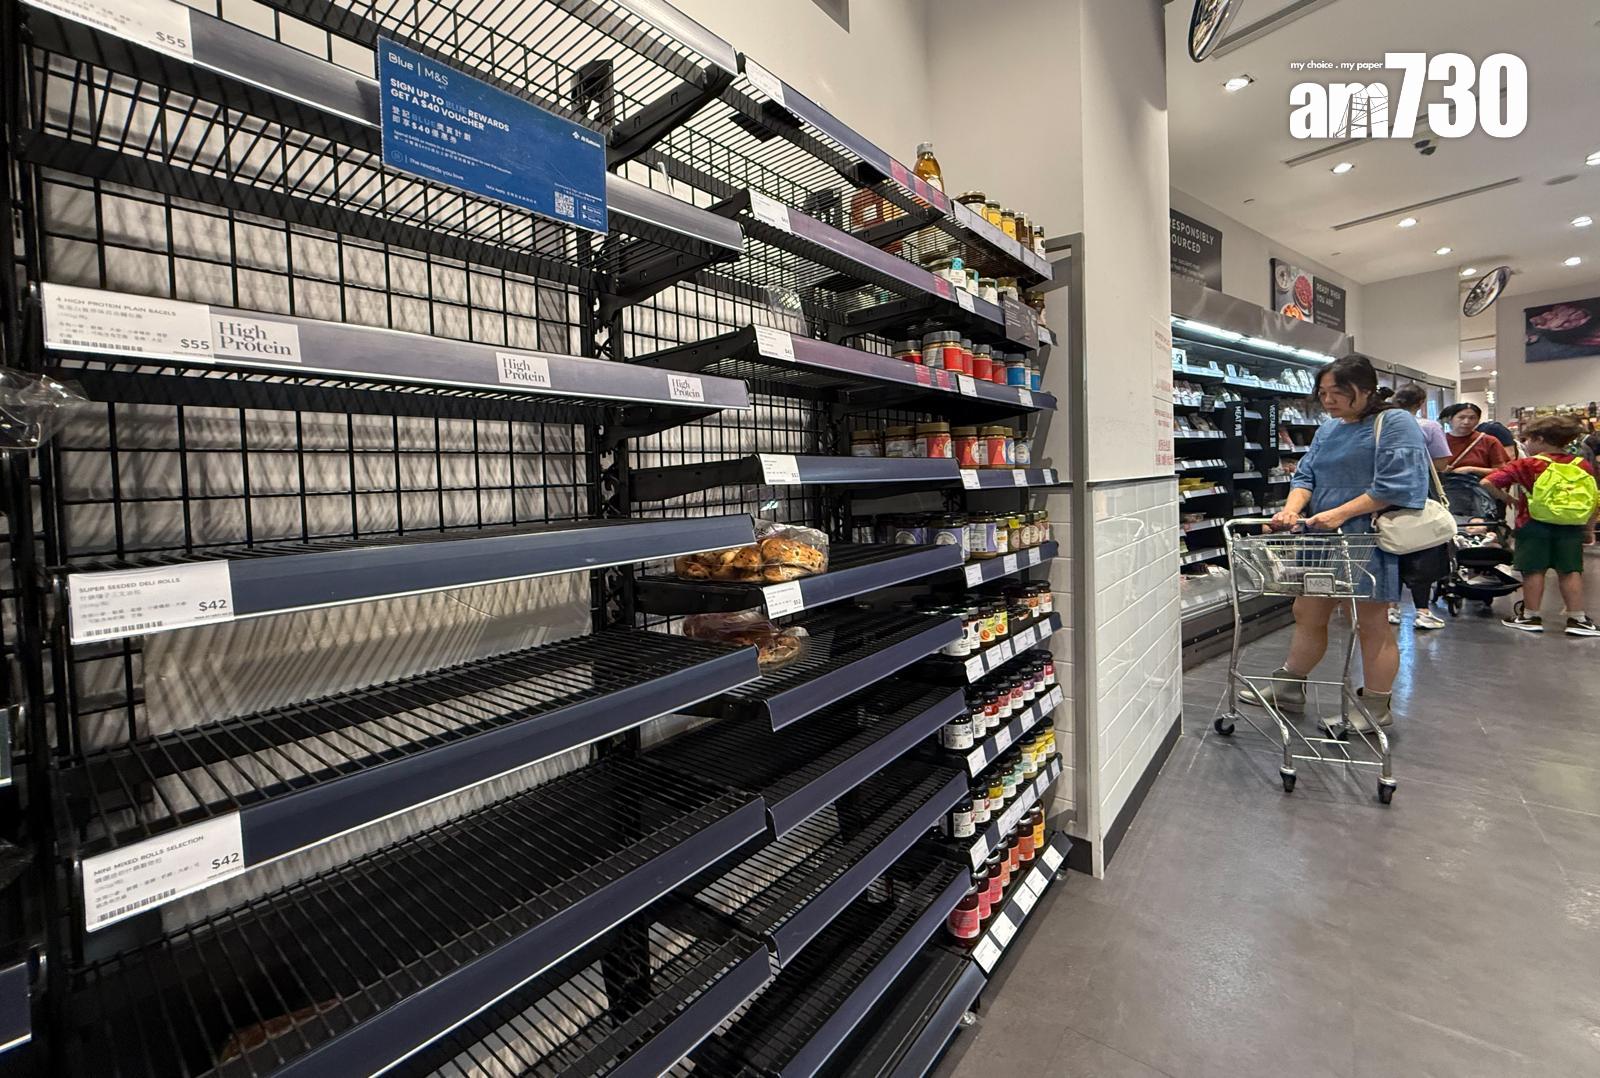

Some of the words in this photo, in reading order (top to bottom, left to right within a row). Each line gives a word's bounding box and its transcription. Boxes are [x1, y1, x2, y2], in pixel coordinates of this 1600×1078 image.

[156, 31, 186, 48] $55
[388, 52, 414, 70] Blue
[424, 68, 448, 86] M&S
[390, 78, 415, 94] SIGN
[416, 88, 430, 99] UP
[430, 92, 445, 106] TO
[446, 101, 468, 114] BLUE
[468, 110, 510, 132] REWARDS
[390, 88, 410, 102] GET
[412, 96, 420, 106] A
[420, 100, 440, 113] $40
[440, 108, 484, 130] VOUCHER
[410, 157, 420, 166] The
[1170, 218, 1215, 246] ESPONSIBLY
[1171, 234, 1201, 254] OURCED
[64, 296, 85, 305] HIGH
[88, 300, 122, 310] PROTEIN
[124, 304, 146, 313] PLAIN
[149, 308, 176, 316] BAGELS
[218, 321, 267, 342] High
[180, 338, 210, 350] $55
[220, 335, 292, 356] Protein
[502, 357, 530, 372] High
[503, 368, 545, 383] Protein
[672, 378, 690, 390] High
[673, 387, 700, 398] Protein
[1234, 406, 1242, 422] MEAT
[79, 585, 105, 593] SUPER
[108, 582, 137, 590] SEEDED
[157, 577, 180, 585] ROLLS
[198, 599, 228, 612] $42
[94, 866, 112, 876] MINI
[114, 857, 138, 869] MIXED
[140, 849, 164, 860] ROLLS
[166, 835, 204, 852] SELECTION
[212, 852, 240, 870] $42
